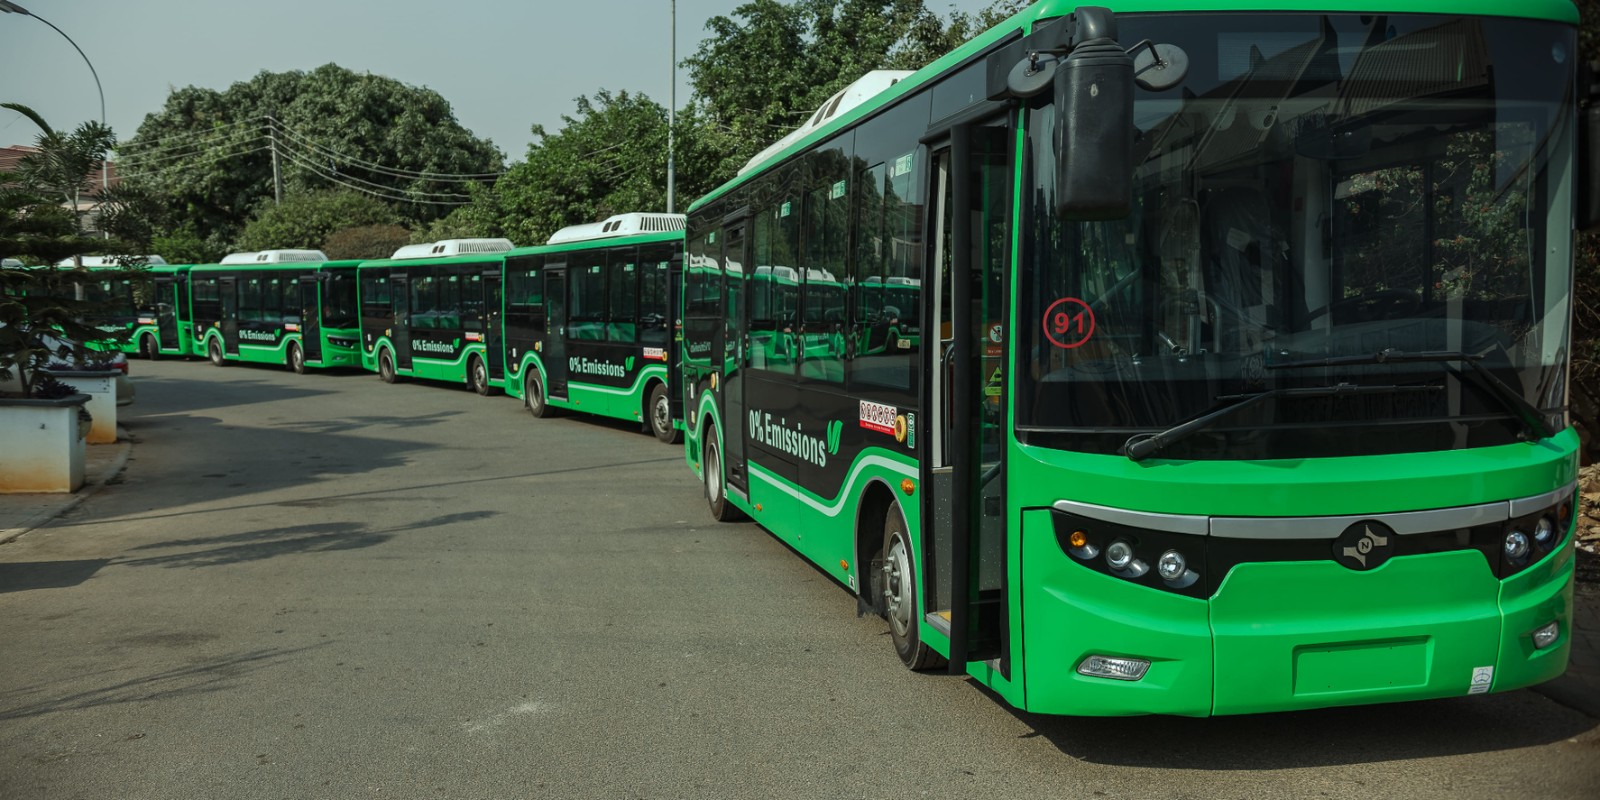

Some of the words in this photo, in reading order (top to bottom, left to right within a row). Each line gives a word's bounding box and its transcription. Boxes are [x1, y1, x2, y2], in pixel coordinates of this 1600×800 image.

[1055, 312, 1084, 334] 91
[412, 339, 422, 351] 0%
[422, 339, 454, 353] Emissions
[569, 356, 581, 373] 0%
[581, 357, 625, 378] Emissions
[749, 409, 764, 442] 0%
[765, 412, 826, 467] Emissions
